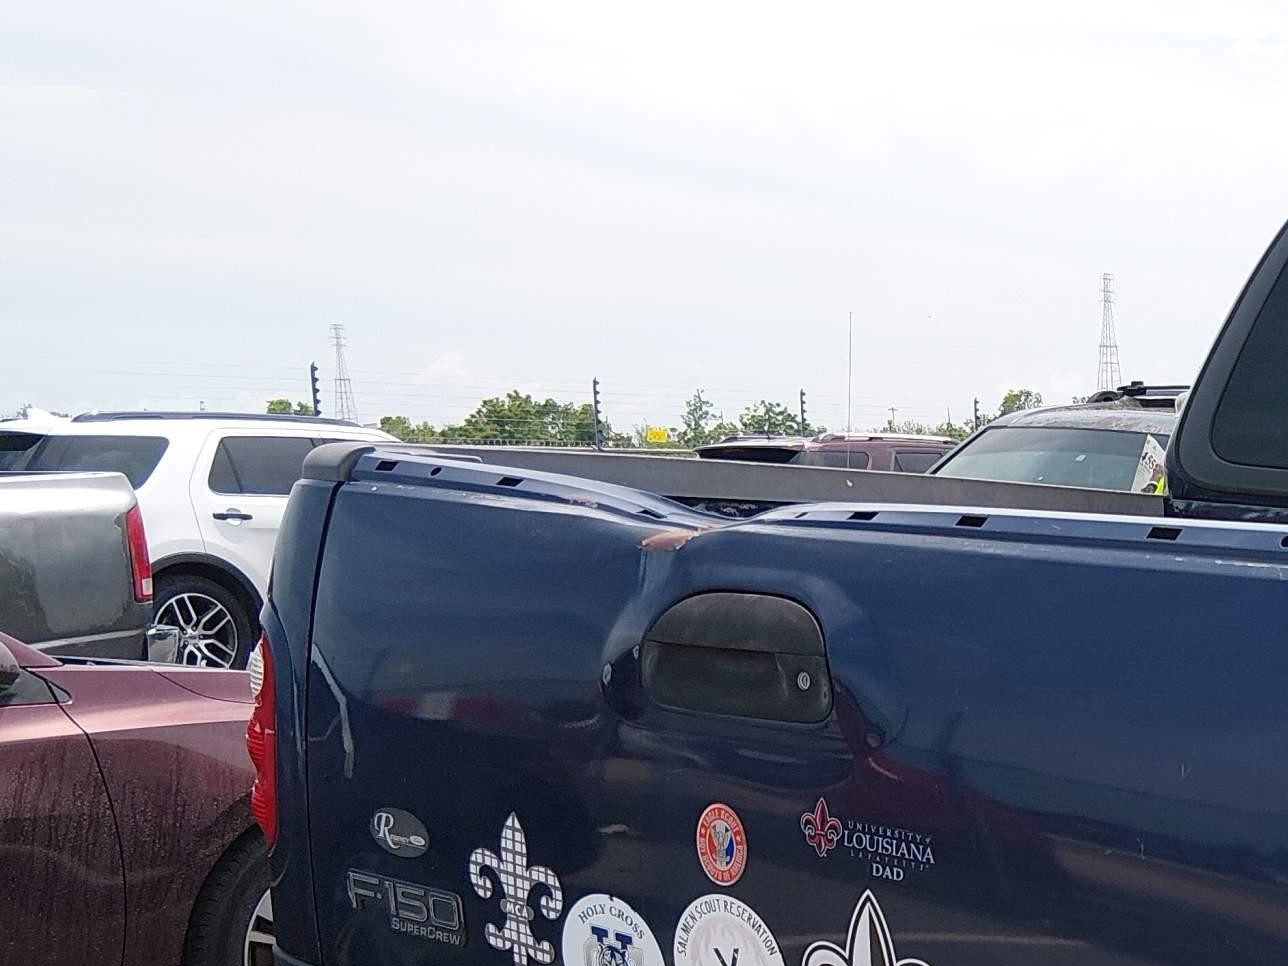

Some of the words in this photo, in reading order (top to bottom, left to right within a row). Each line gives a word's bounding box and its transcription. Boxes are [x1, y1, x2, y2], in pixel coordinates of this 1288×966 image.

[848, 820, 922, 843] UNIVERSITY
[843, 830, 936, 864] LOUISIANA
[871, 862, 904, 881] DAD
[506, 901, 528, 918] MCA
[578, 903, 606, 924] HOLY
[609, 906, 645, 939] CROSS
[677, 910, 698, 957] SALMEN
[695, 898, 720, 919] SCOUT
[723, 900, 778, 956] RESERVATION
